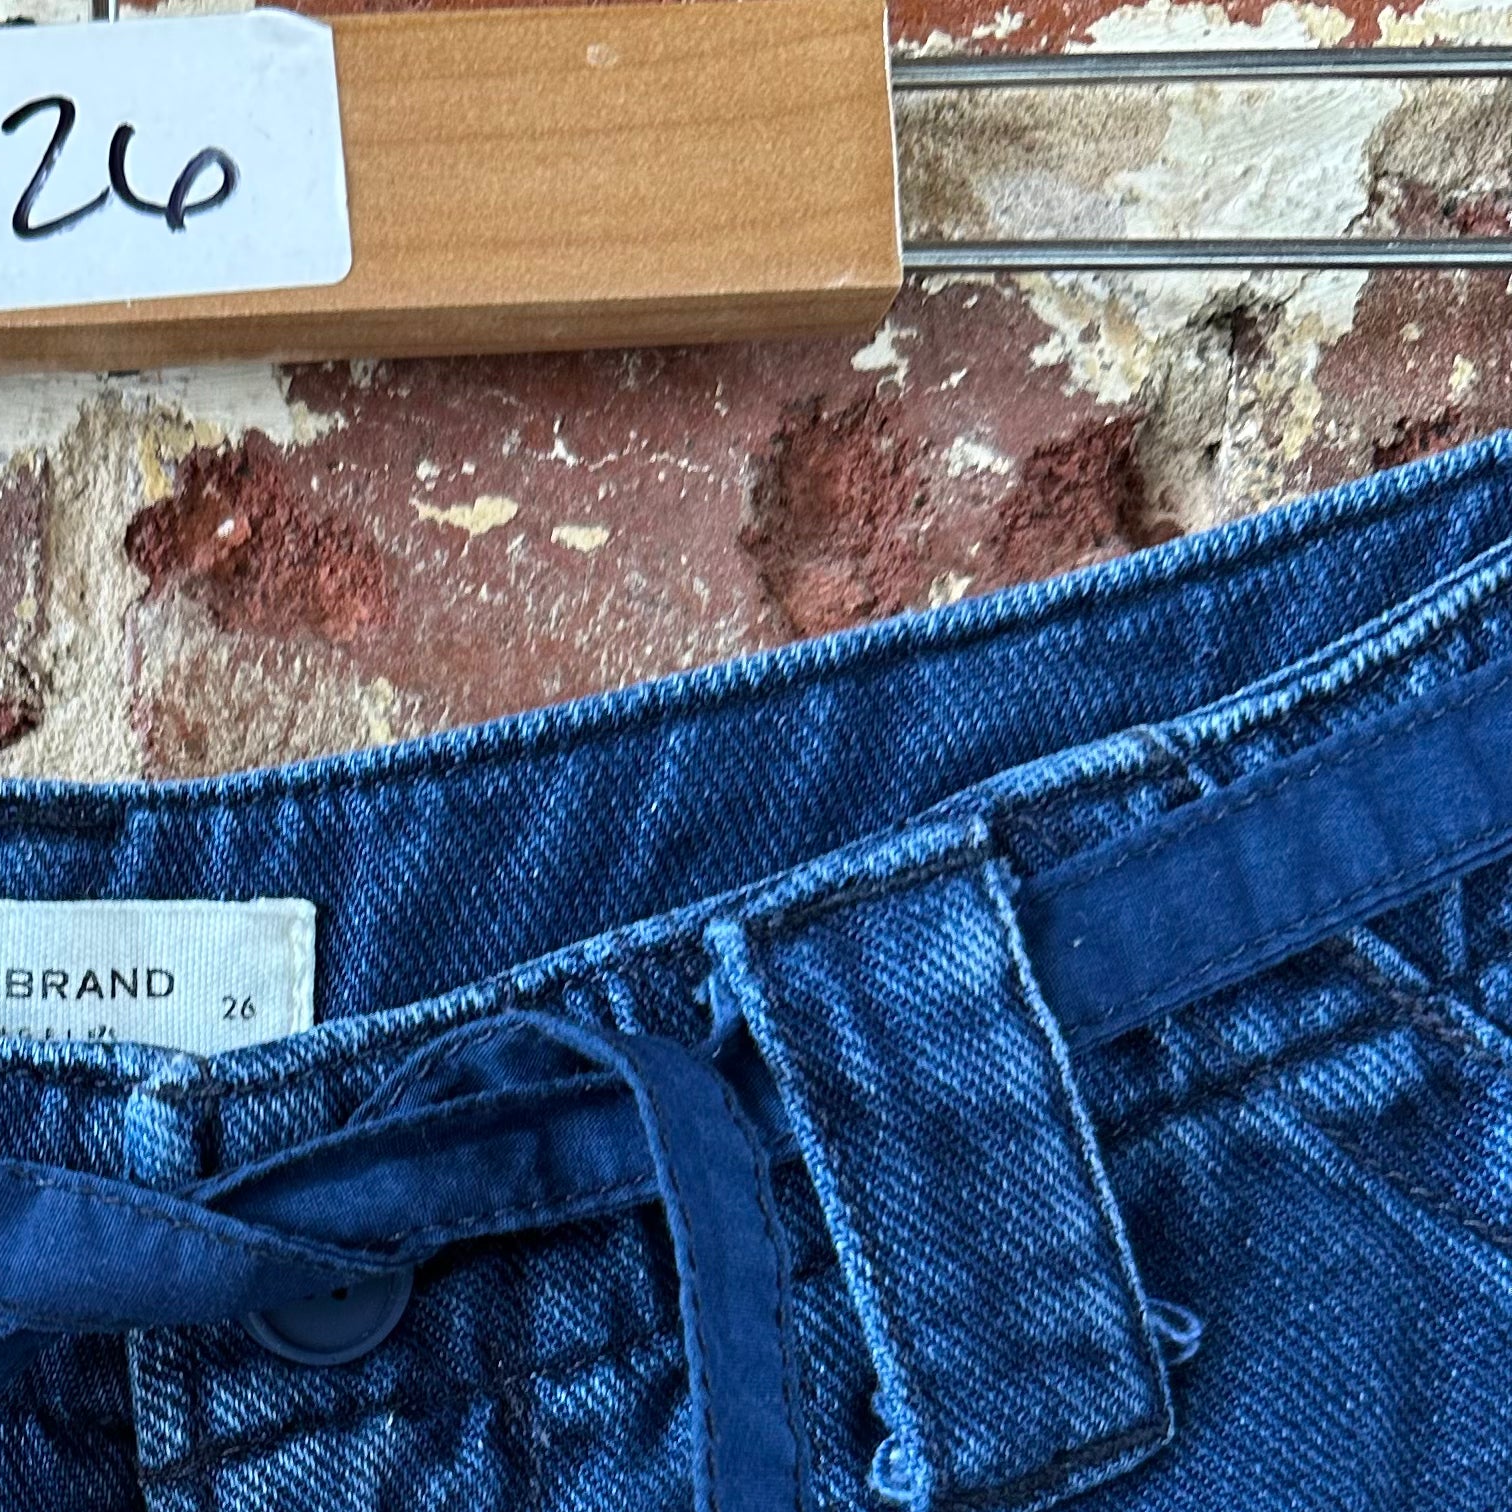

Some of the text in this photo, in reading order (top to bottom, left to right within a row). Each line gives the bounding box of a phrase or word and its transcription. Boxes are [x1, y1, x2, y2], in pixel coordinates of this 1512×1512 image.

[1, 94, 240, 241] 26
[5, 967, 176, 1000] BRAND
[222, 994, 257, 1021] 26
